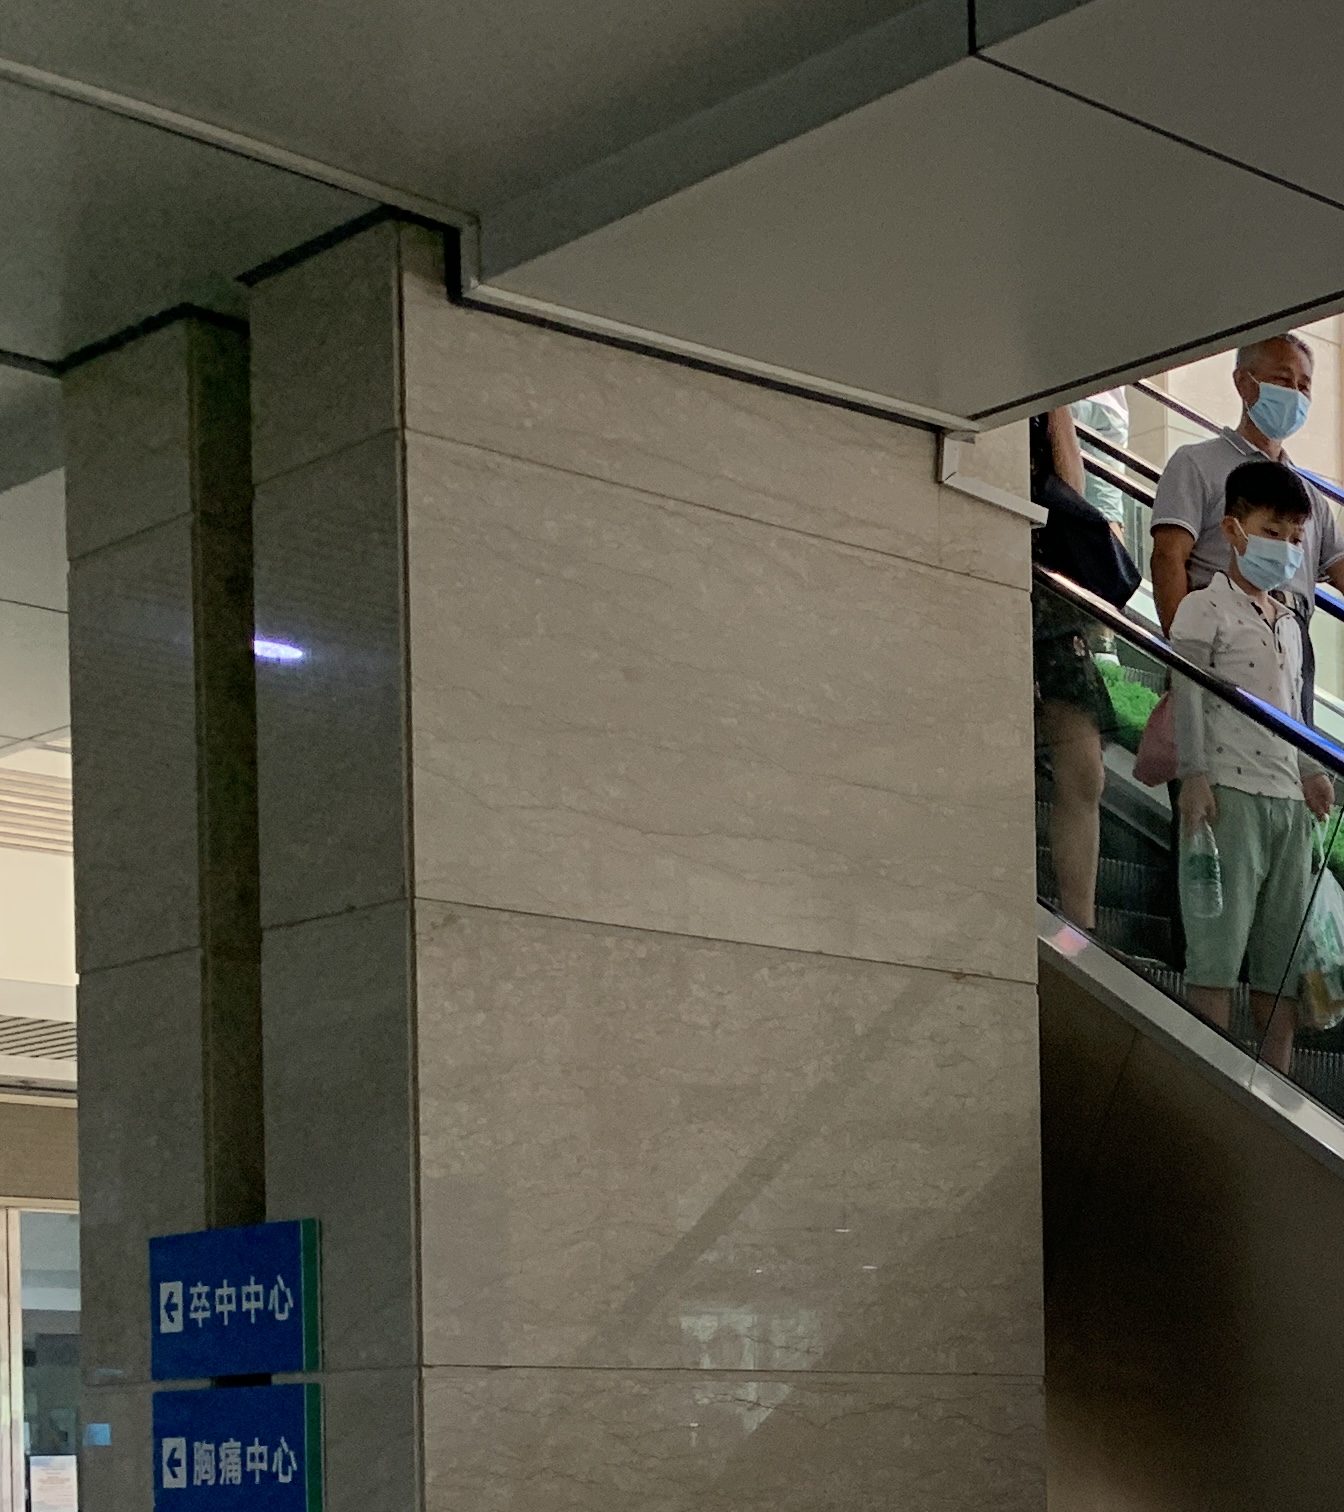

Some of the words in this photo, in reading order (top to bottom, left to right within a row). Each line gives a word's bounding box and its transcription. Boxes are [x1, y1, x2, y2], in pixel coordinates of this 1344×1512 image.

[188, 1274, 294, 1328] 卒中中心
[192, 1435, 298, 1486] 胸痛中心
